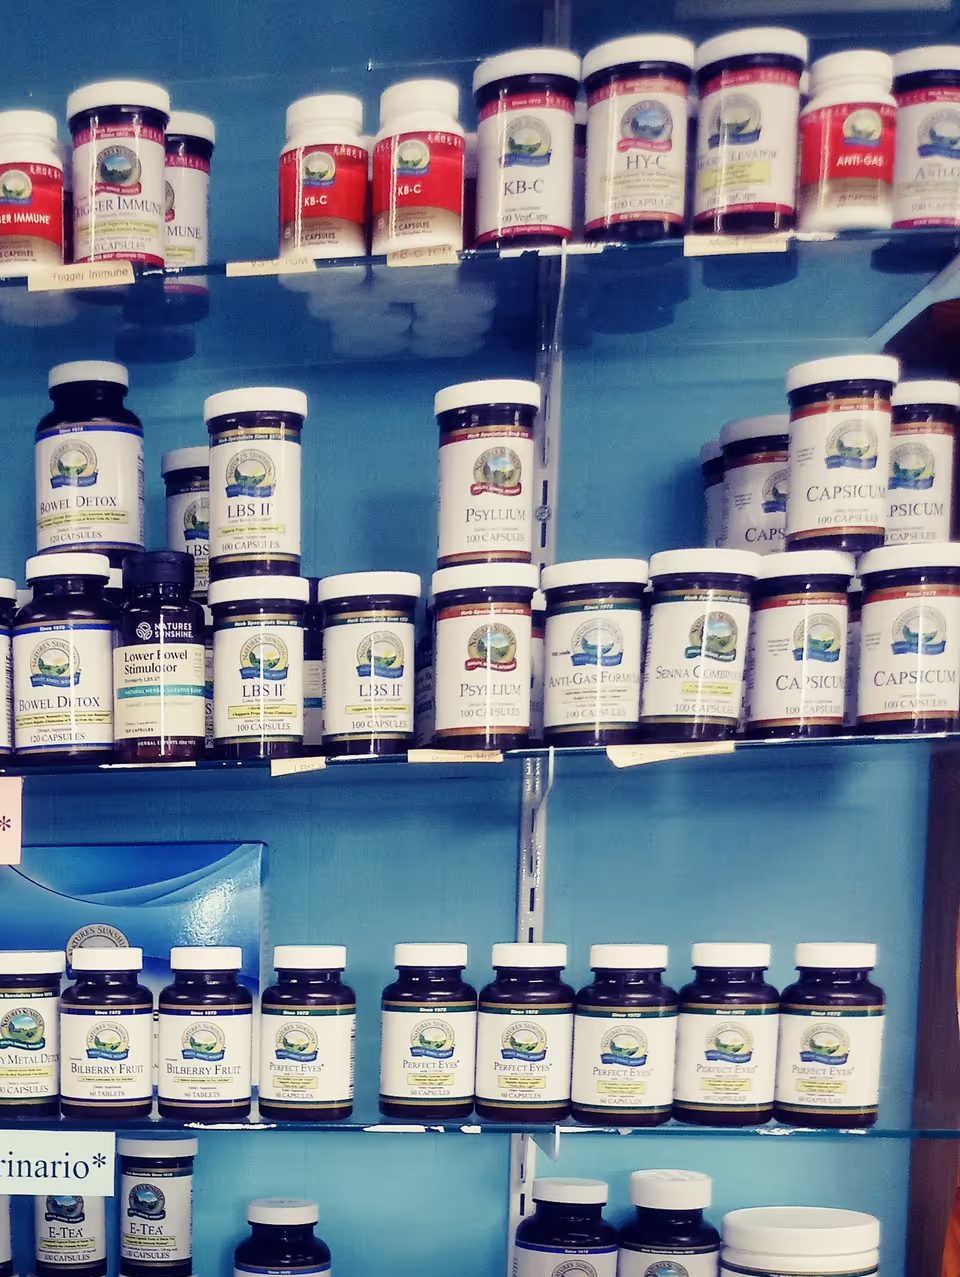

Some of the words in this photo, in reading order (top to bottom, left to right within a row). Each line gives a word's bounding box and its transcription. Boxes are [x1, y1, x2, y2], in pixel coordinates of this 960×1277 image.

[13, 213, 50, 225] IMMUNE
[52, 270, 85, 284] Trigger
[88, 267, 129, 279] Immune
[74, 495, 117, 508] DETOX
[227, 503, 256, 518] LBS
[465, 508, 526, 523] PSYLLIUM
[124, 650, 153, 662] Lower
[124, 662, 177, 675] Stimulator
[873, 670, 956, 687] CAPSICUM
[18, 699, 56, 712] BOWEL
[7, 1053, 39, 1064] METAL
[402, 1059, 436, 1069] PERFECT
[70, 1063, 116, 1075] BILBERRY
[119, 1064, 144, 1075] FRUIT
[166, 1063, 211, 1075] BILBERRY
[269, 1061, 299, 1072] PERFECT
[494, 1061, 527, 1073] PERFECT
[592, 1066, 627, 1077] PERFECT
